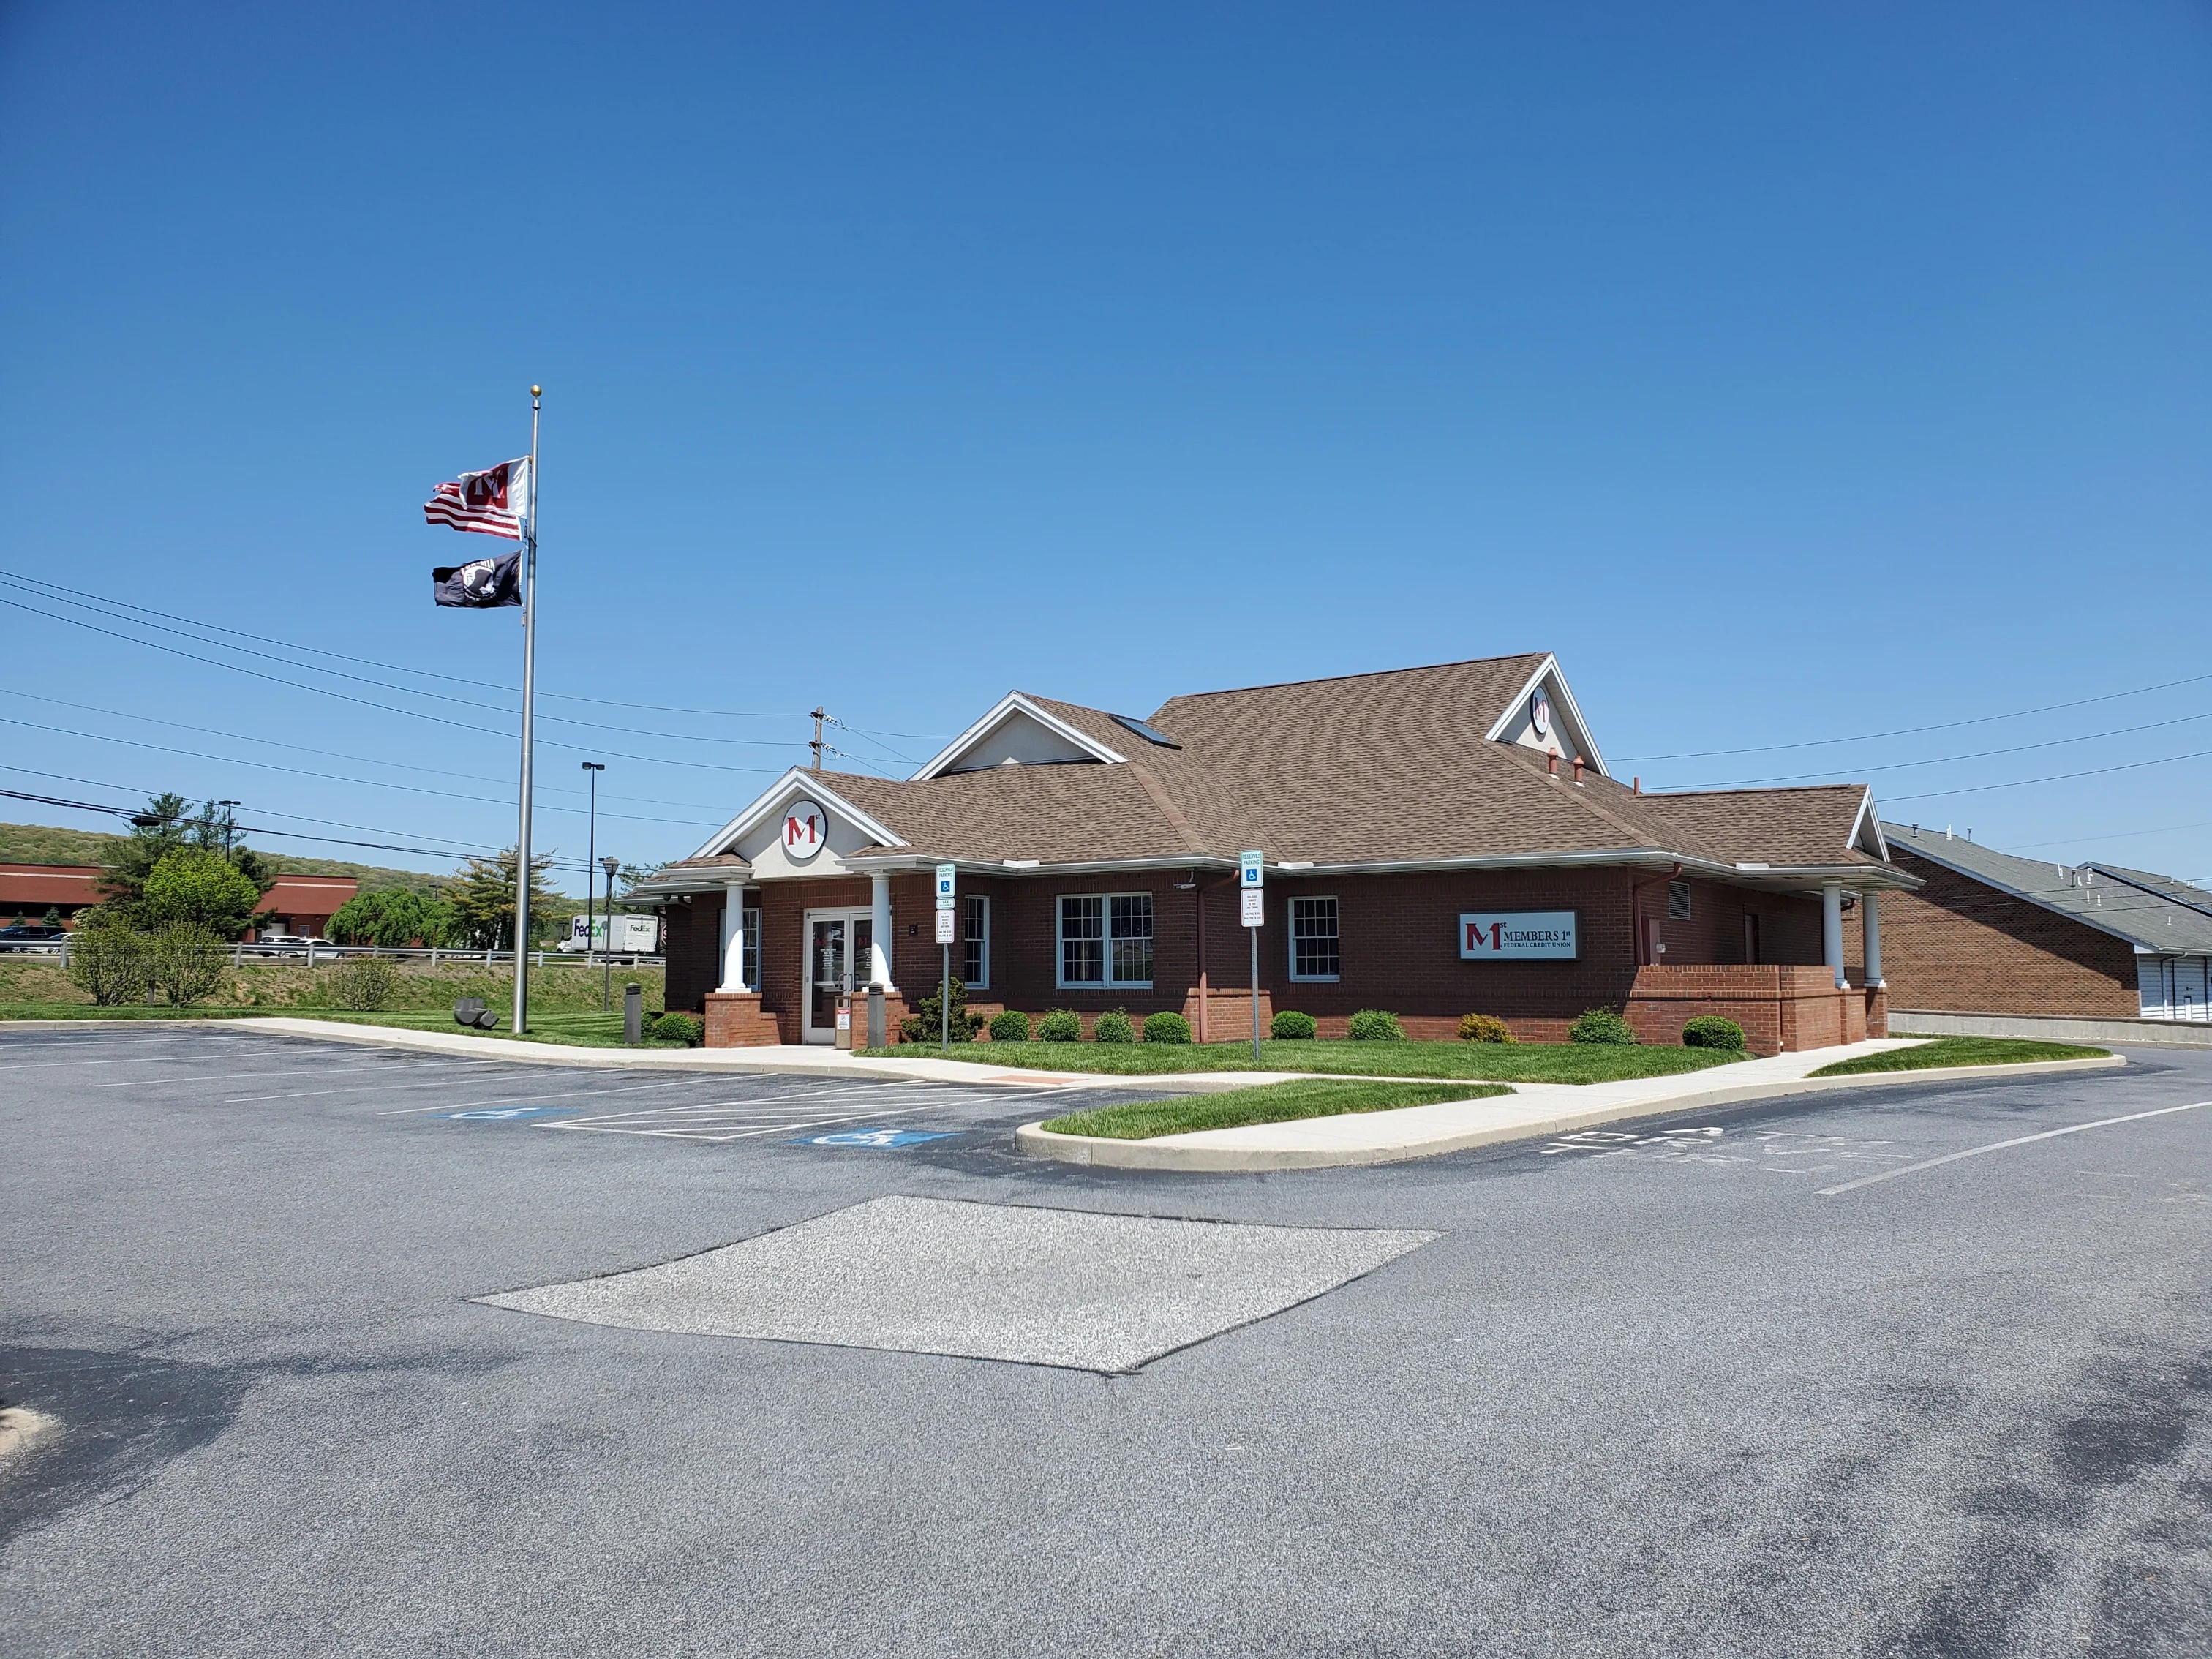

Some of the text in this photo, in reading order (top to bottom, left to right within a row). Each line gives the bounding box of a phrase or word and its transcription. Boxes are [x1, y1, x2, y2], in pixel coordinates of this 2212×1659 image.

[630, 924, 651, 933] FedEx
[1503, 930, 1571, 941] MEMBERS 1st
